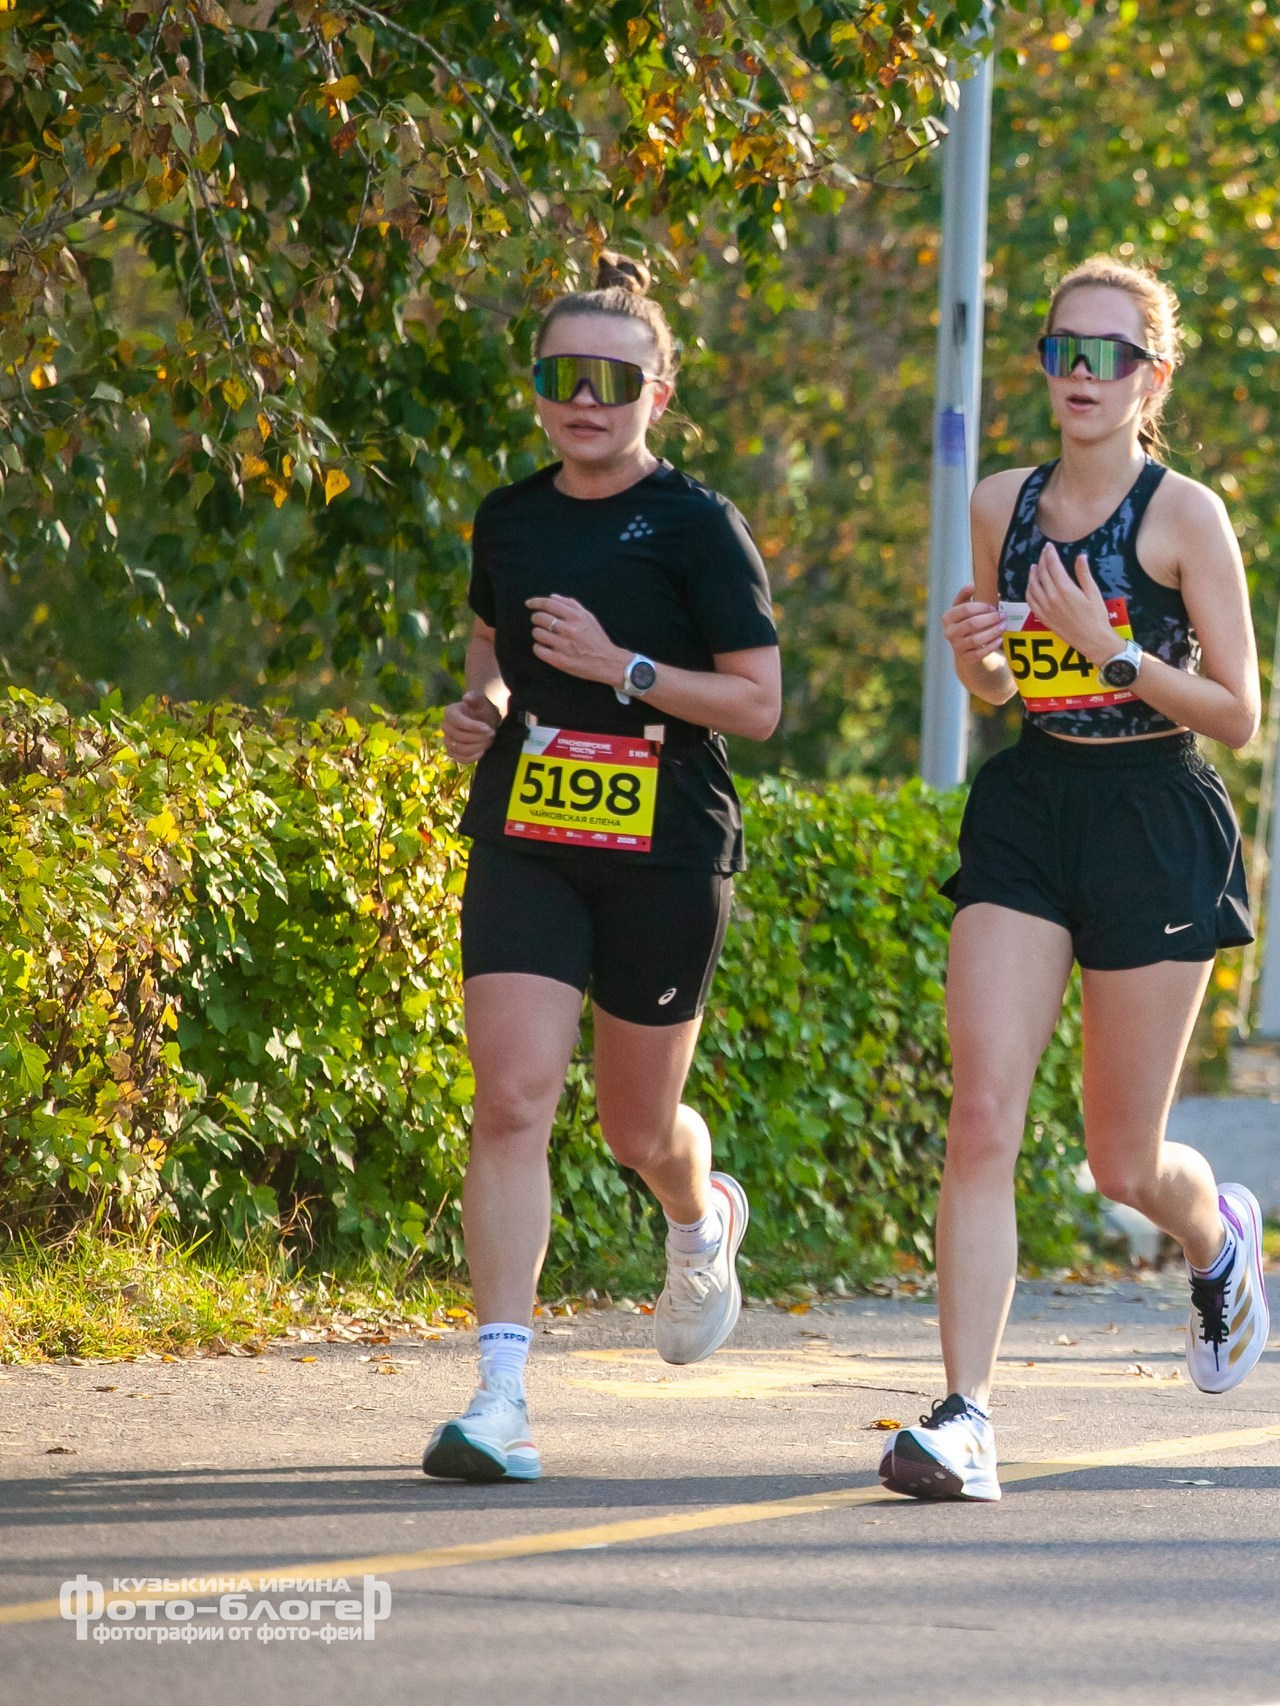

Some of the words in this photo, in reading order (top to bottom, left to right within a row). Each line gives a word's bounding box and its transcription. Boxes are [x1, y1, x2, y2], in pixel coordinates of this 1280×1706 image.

[1008, 638, 1094, 680] 554
[519, 761, 641, 816] 5198
[528, 809, 587, 823] ЧАЙКОВСКАЯ
[589, 817, 622, 827] ЕЛЕНА
